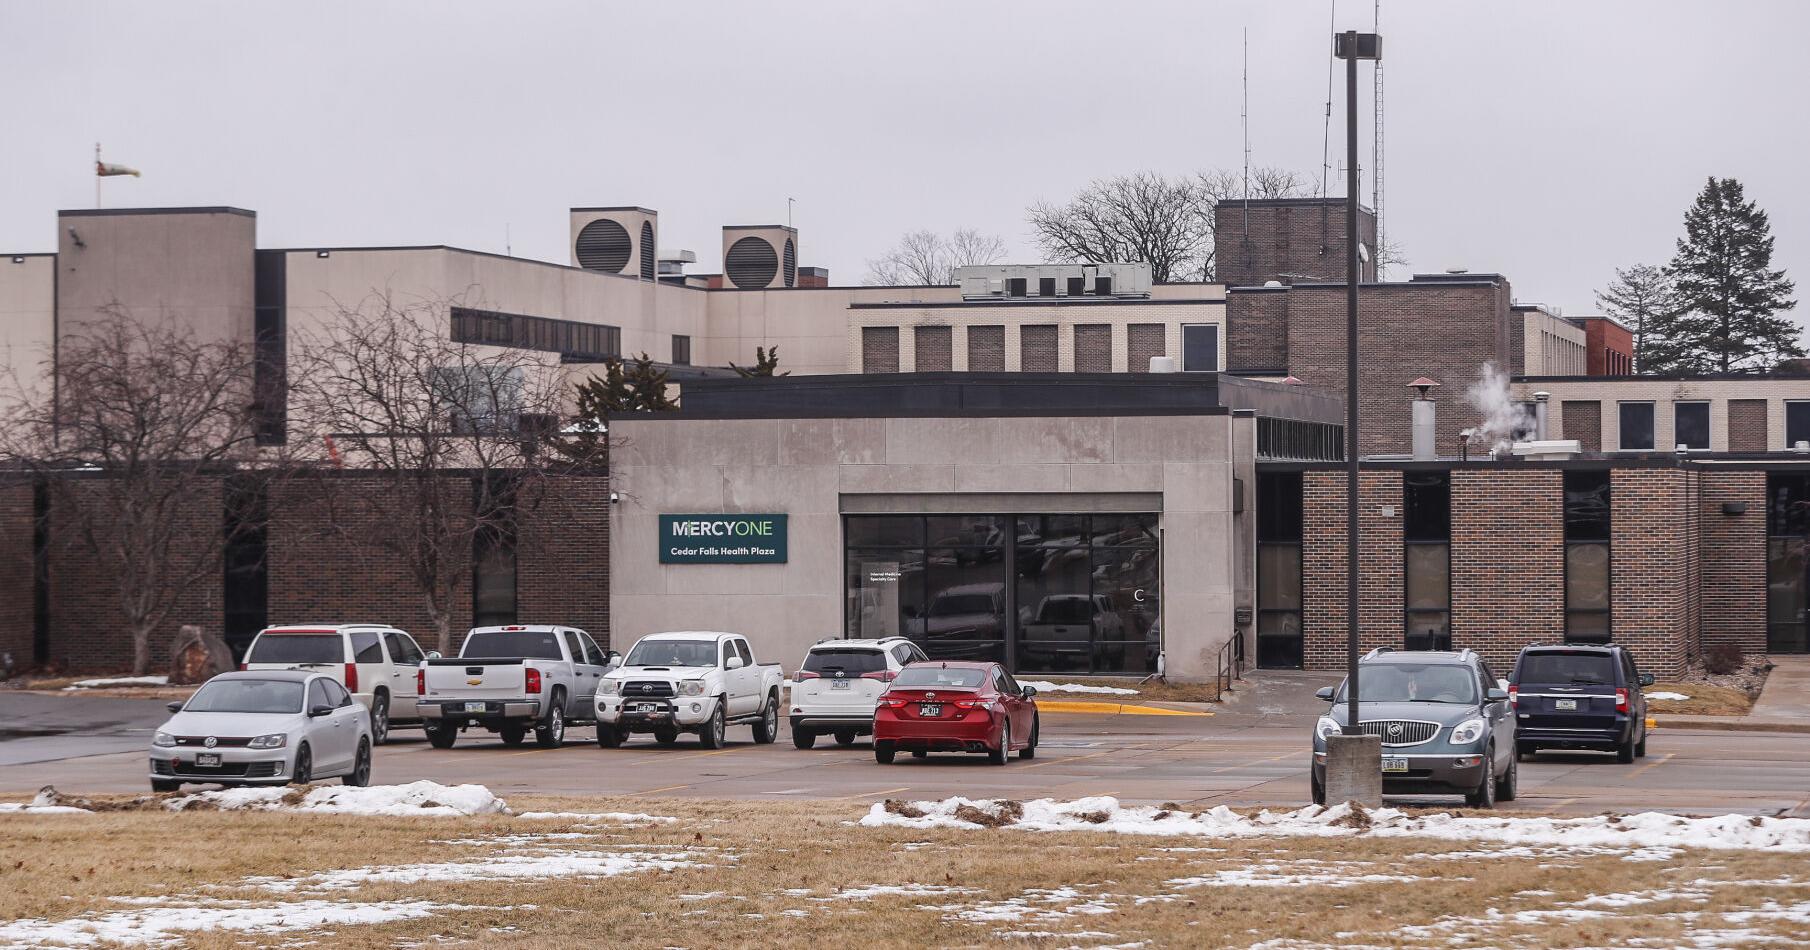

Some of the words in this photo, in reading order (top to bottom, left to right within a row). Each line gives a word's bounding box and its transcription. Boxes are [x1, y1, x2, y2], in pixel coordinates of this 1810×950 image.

[670, 547, 698, 556] Cedar
[699, 547, 719, 556] Falls
[720, 547, 749, 556] Health
[750, 547, 775, 556] Plaza
[1134, 589, 1145, 602] C
